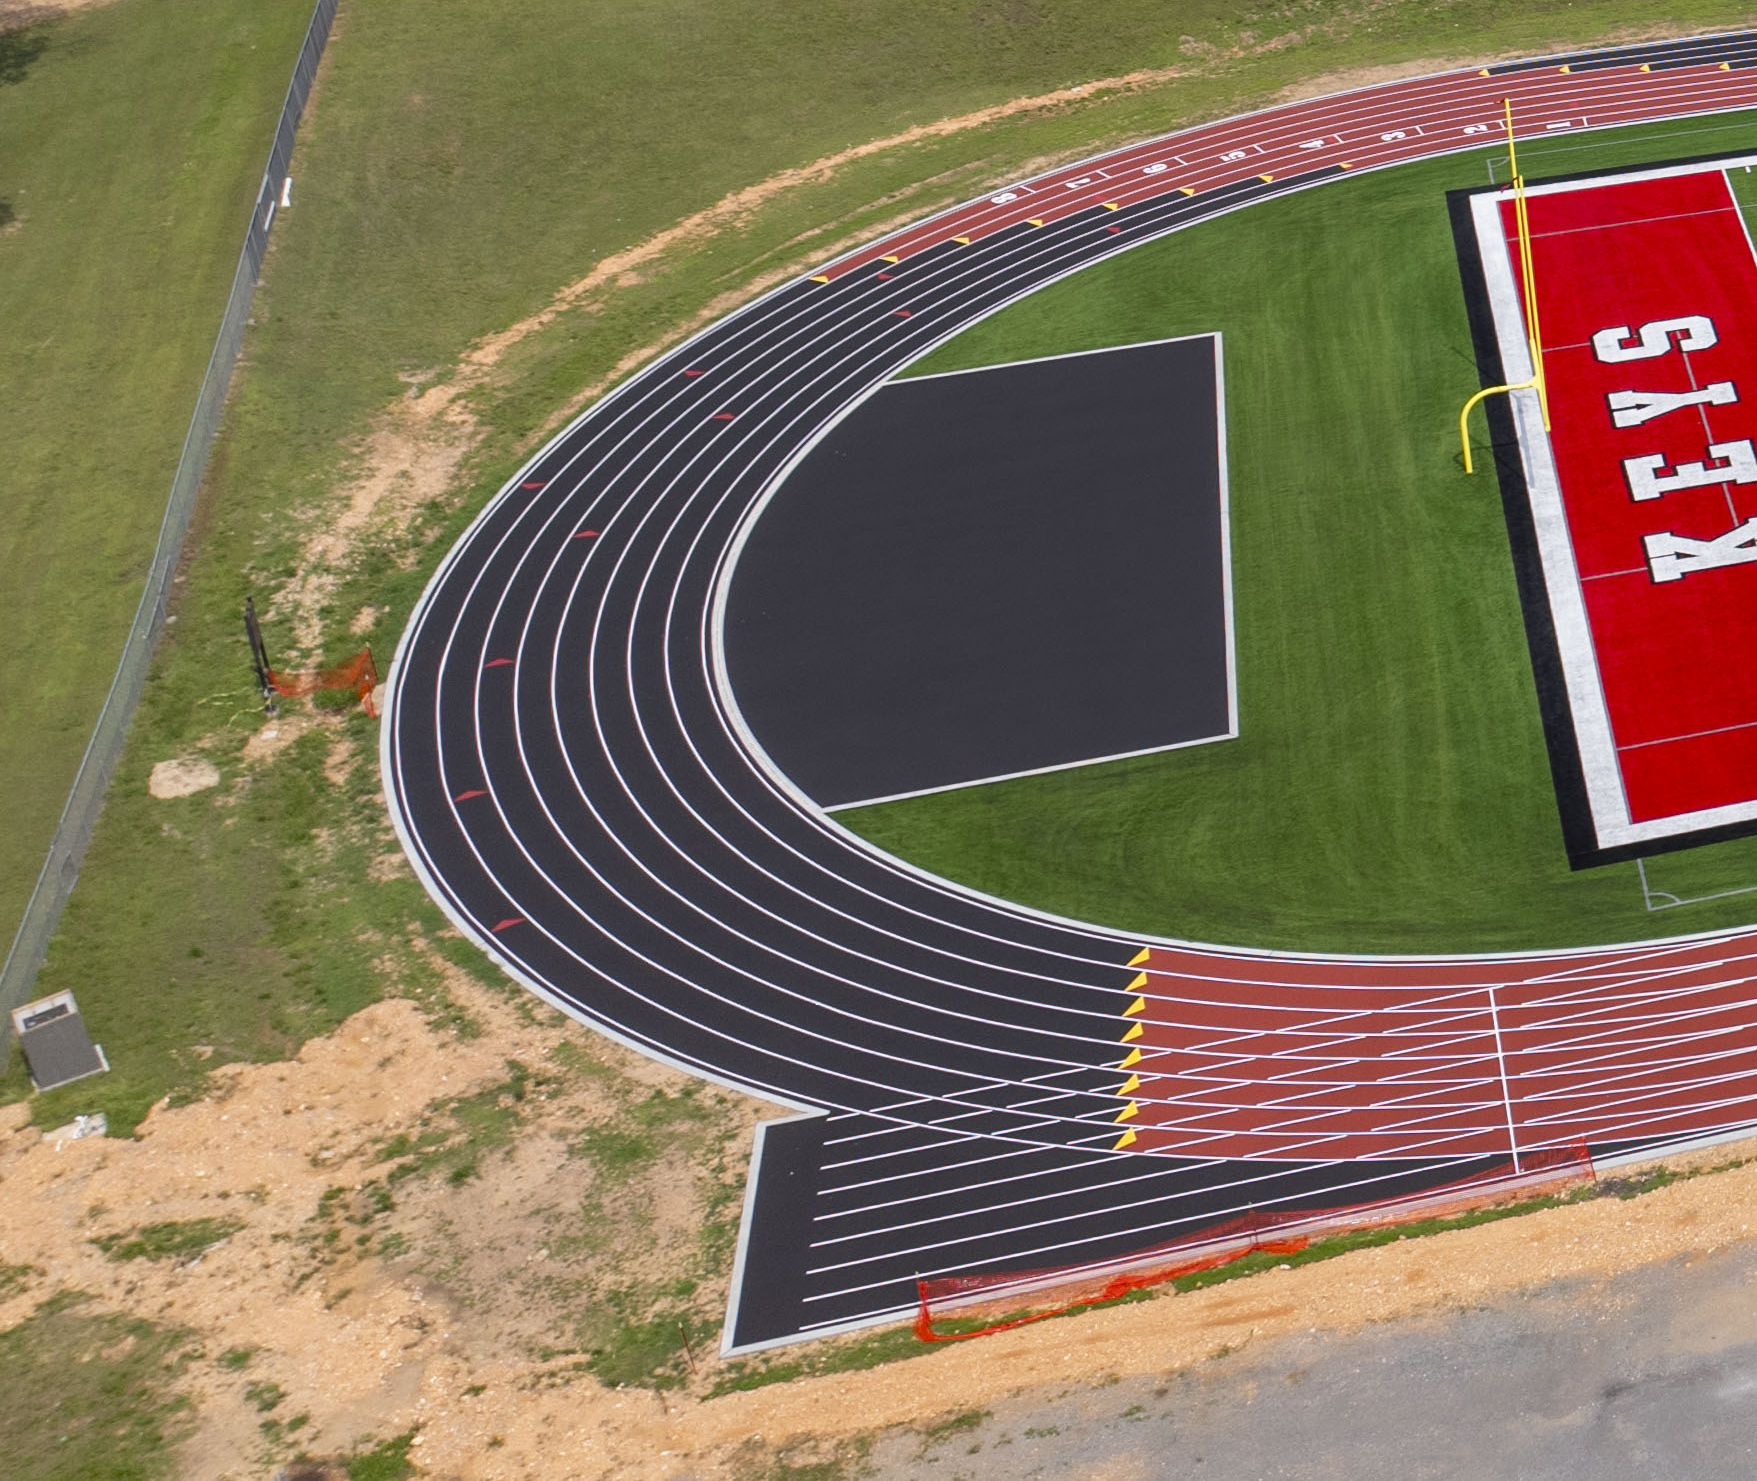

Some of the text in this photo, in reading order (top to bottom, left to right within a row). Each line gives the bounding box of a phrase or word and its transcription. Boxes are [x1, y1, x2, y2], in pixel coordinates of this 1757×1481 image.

[1463, 123, 1488, 135] 2
[1546, 120, 1571, 130] 1
[1381, 130, 1406, 141] 3
[1142, 162, 1168, 174] 6
[990, 191, 1018, 204] 8
